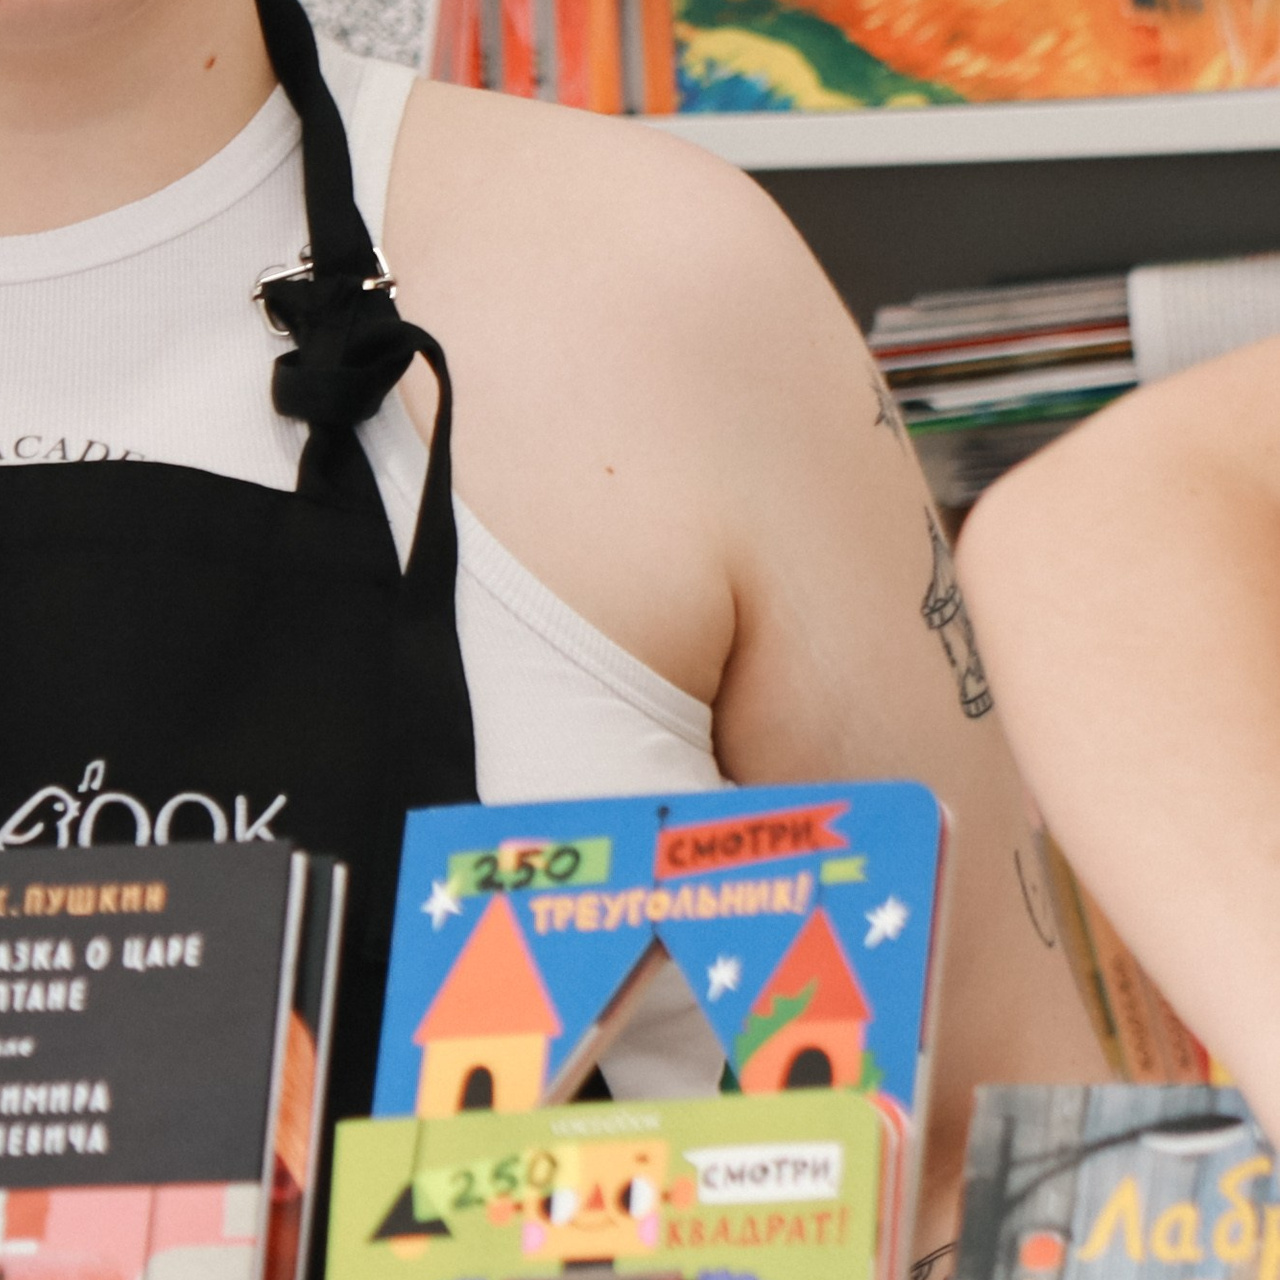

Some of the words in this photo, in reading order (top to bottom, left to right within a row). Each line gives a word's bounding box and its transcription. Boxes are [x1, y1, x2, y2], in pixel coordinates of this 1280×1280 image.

[472, 845, 582, 892] 250
[528, 869, 814, 936] ТРЕУГОЛЬНИК!
[84, 935, 110, 970] О
[121, 931, 205, 976] ЦАРЕ
[450, 1150, 558, 1210] 250
[665, 1205, 851, 1249] КВАДРАТ!
